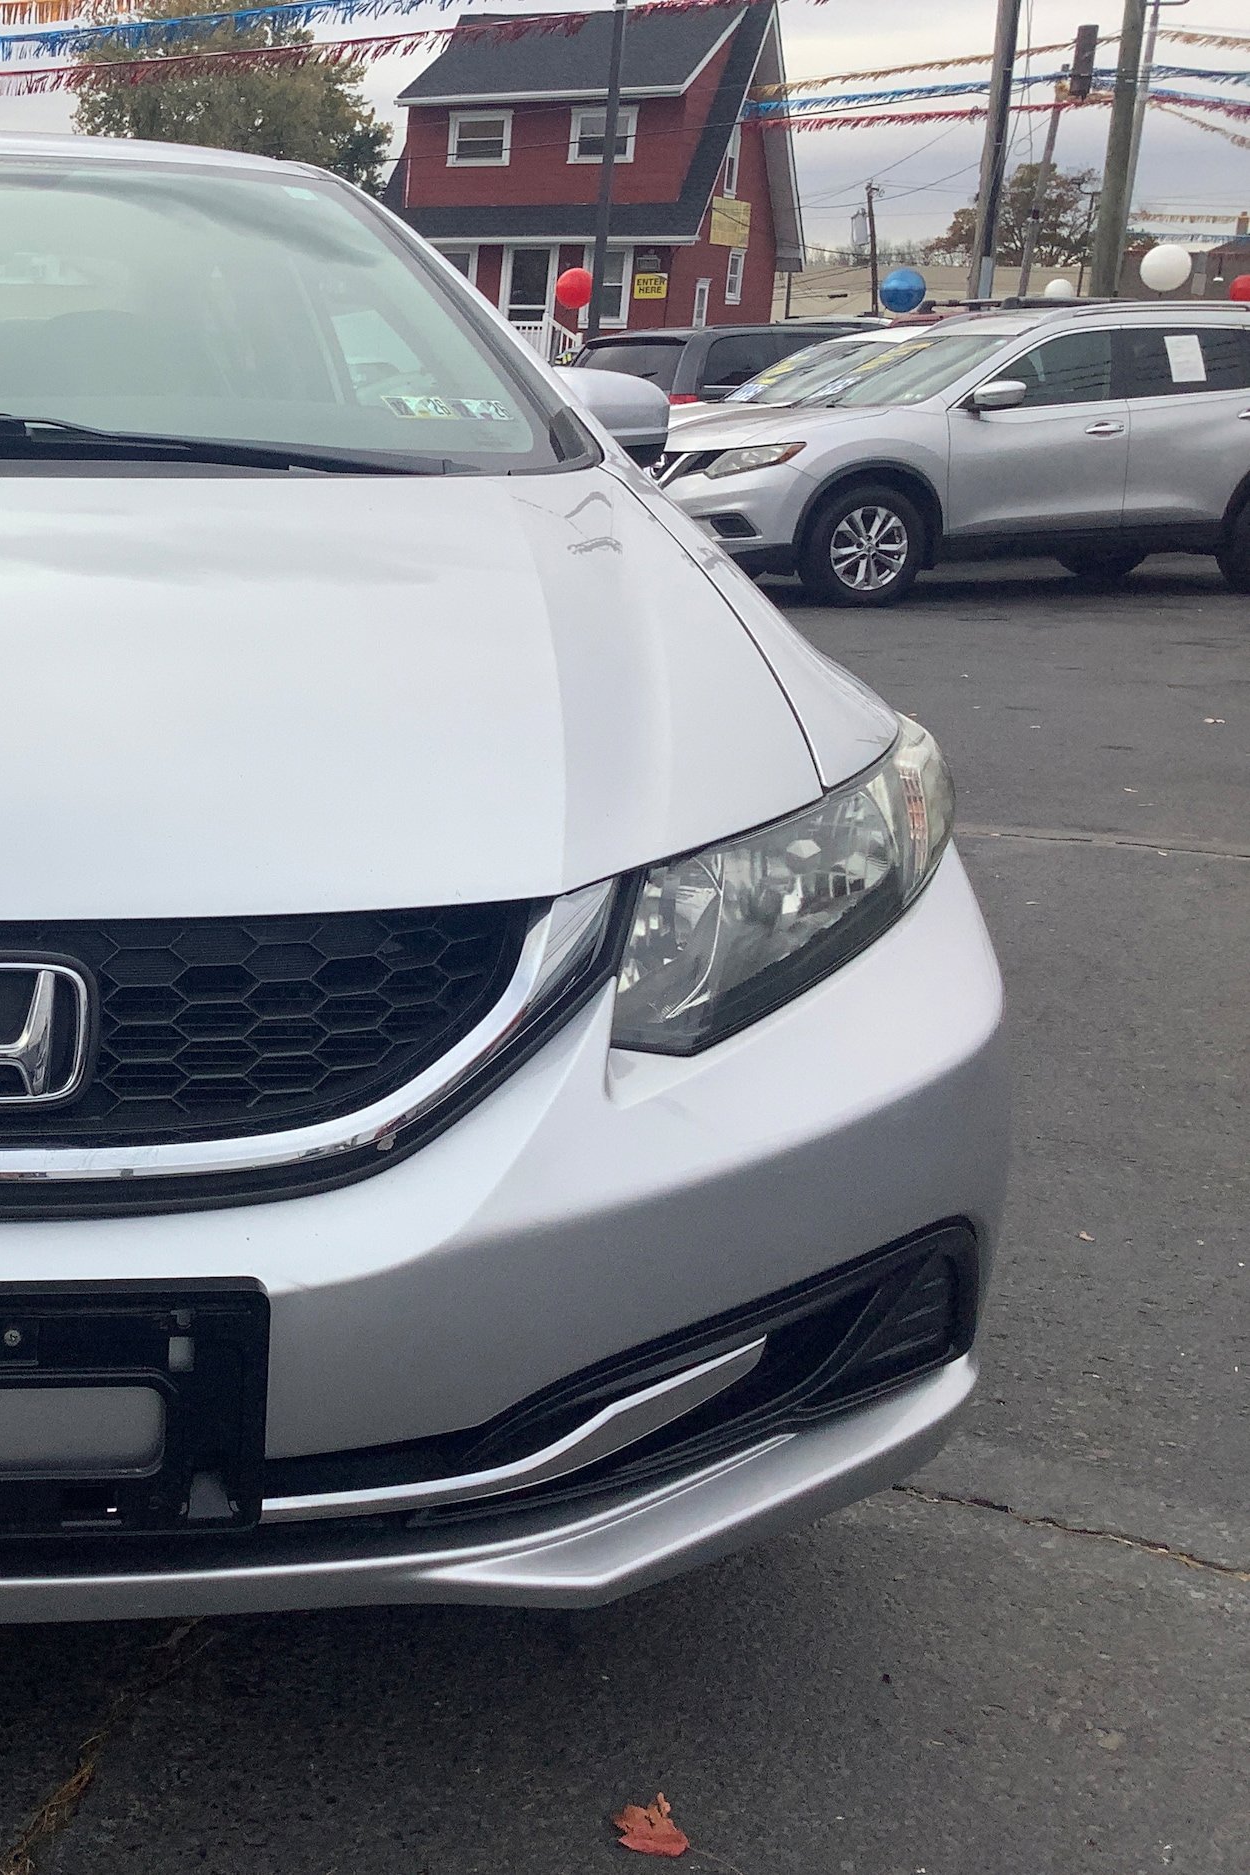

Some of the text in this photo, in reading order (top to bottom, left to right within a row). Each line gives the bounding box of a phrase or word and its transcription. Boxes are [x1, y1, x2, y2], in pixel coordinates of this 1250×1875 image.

[636, 278, 665, 286] ENTER
[638, 286, 662, 294] HERE
[427, 399, 451, 416] 26
[486, 401, 511, 418] 26
